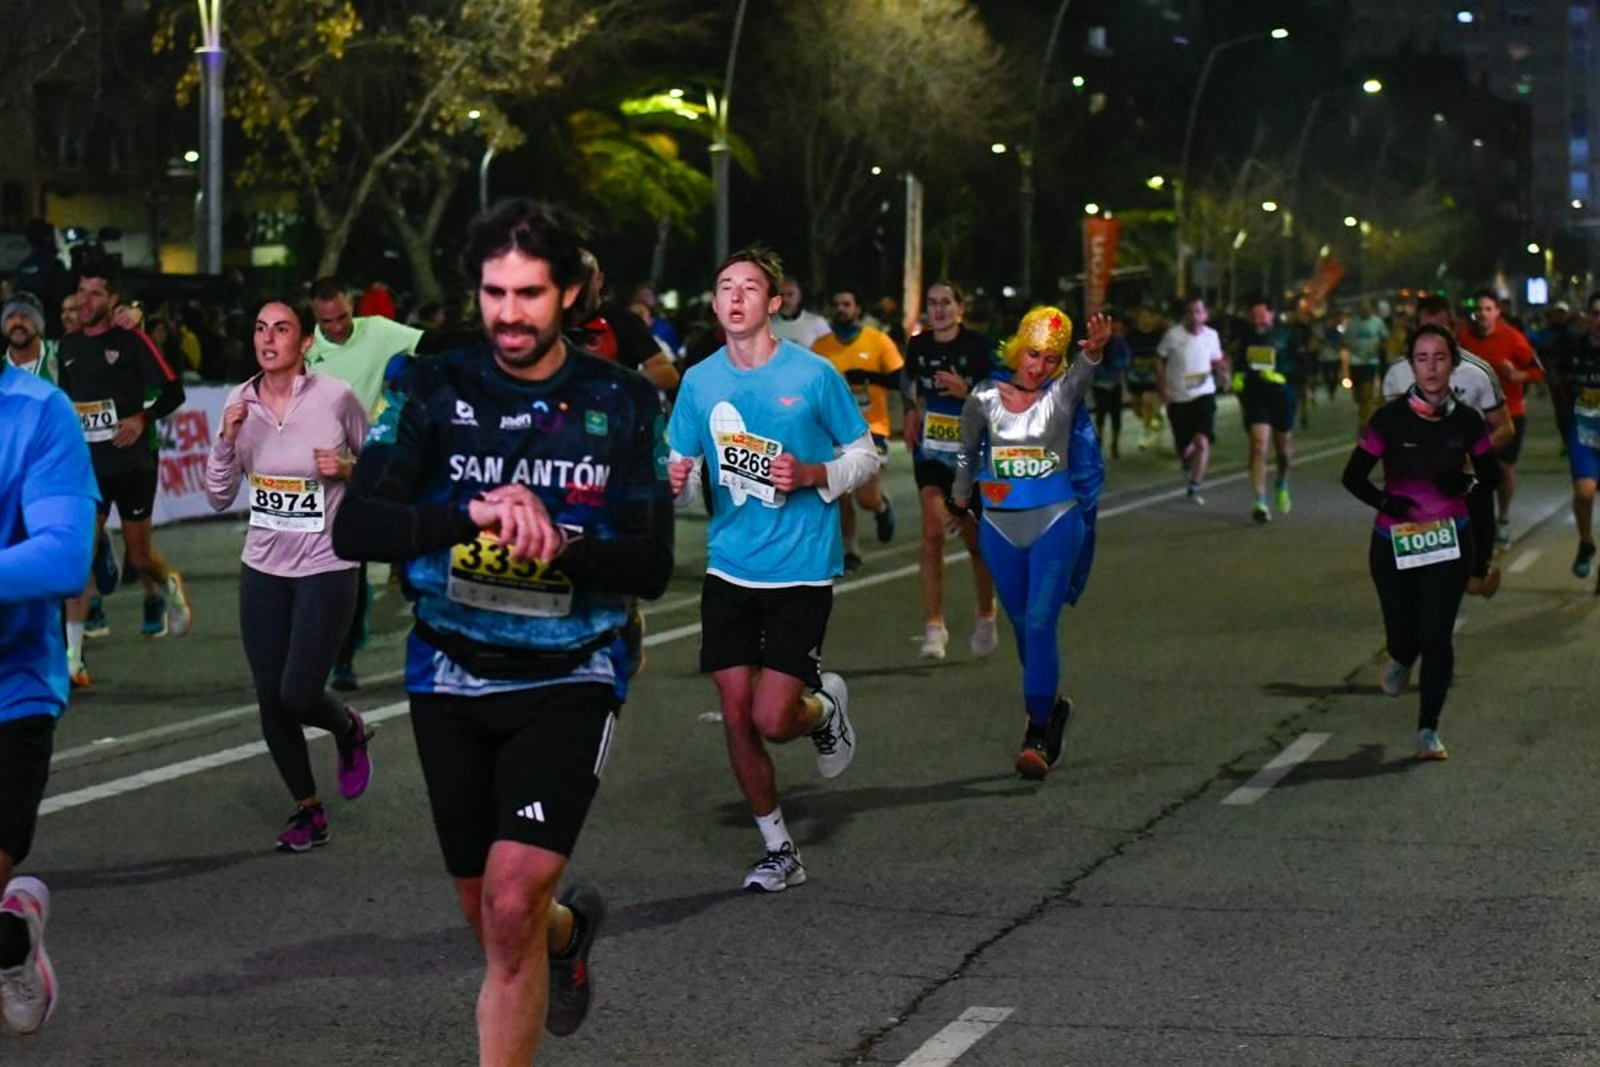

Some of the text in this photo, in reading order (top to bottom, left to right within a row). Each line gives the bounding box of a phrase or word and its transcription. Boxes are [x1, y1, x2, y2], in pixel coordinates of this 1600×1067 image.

[449, 454, 611, 490] SAN ANTÓN
[724, 446, 771, 477] 6269
[255, 488, 318, 512] 8974
[1398, 528, 1452, 552] 1008
